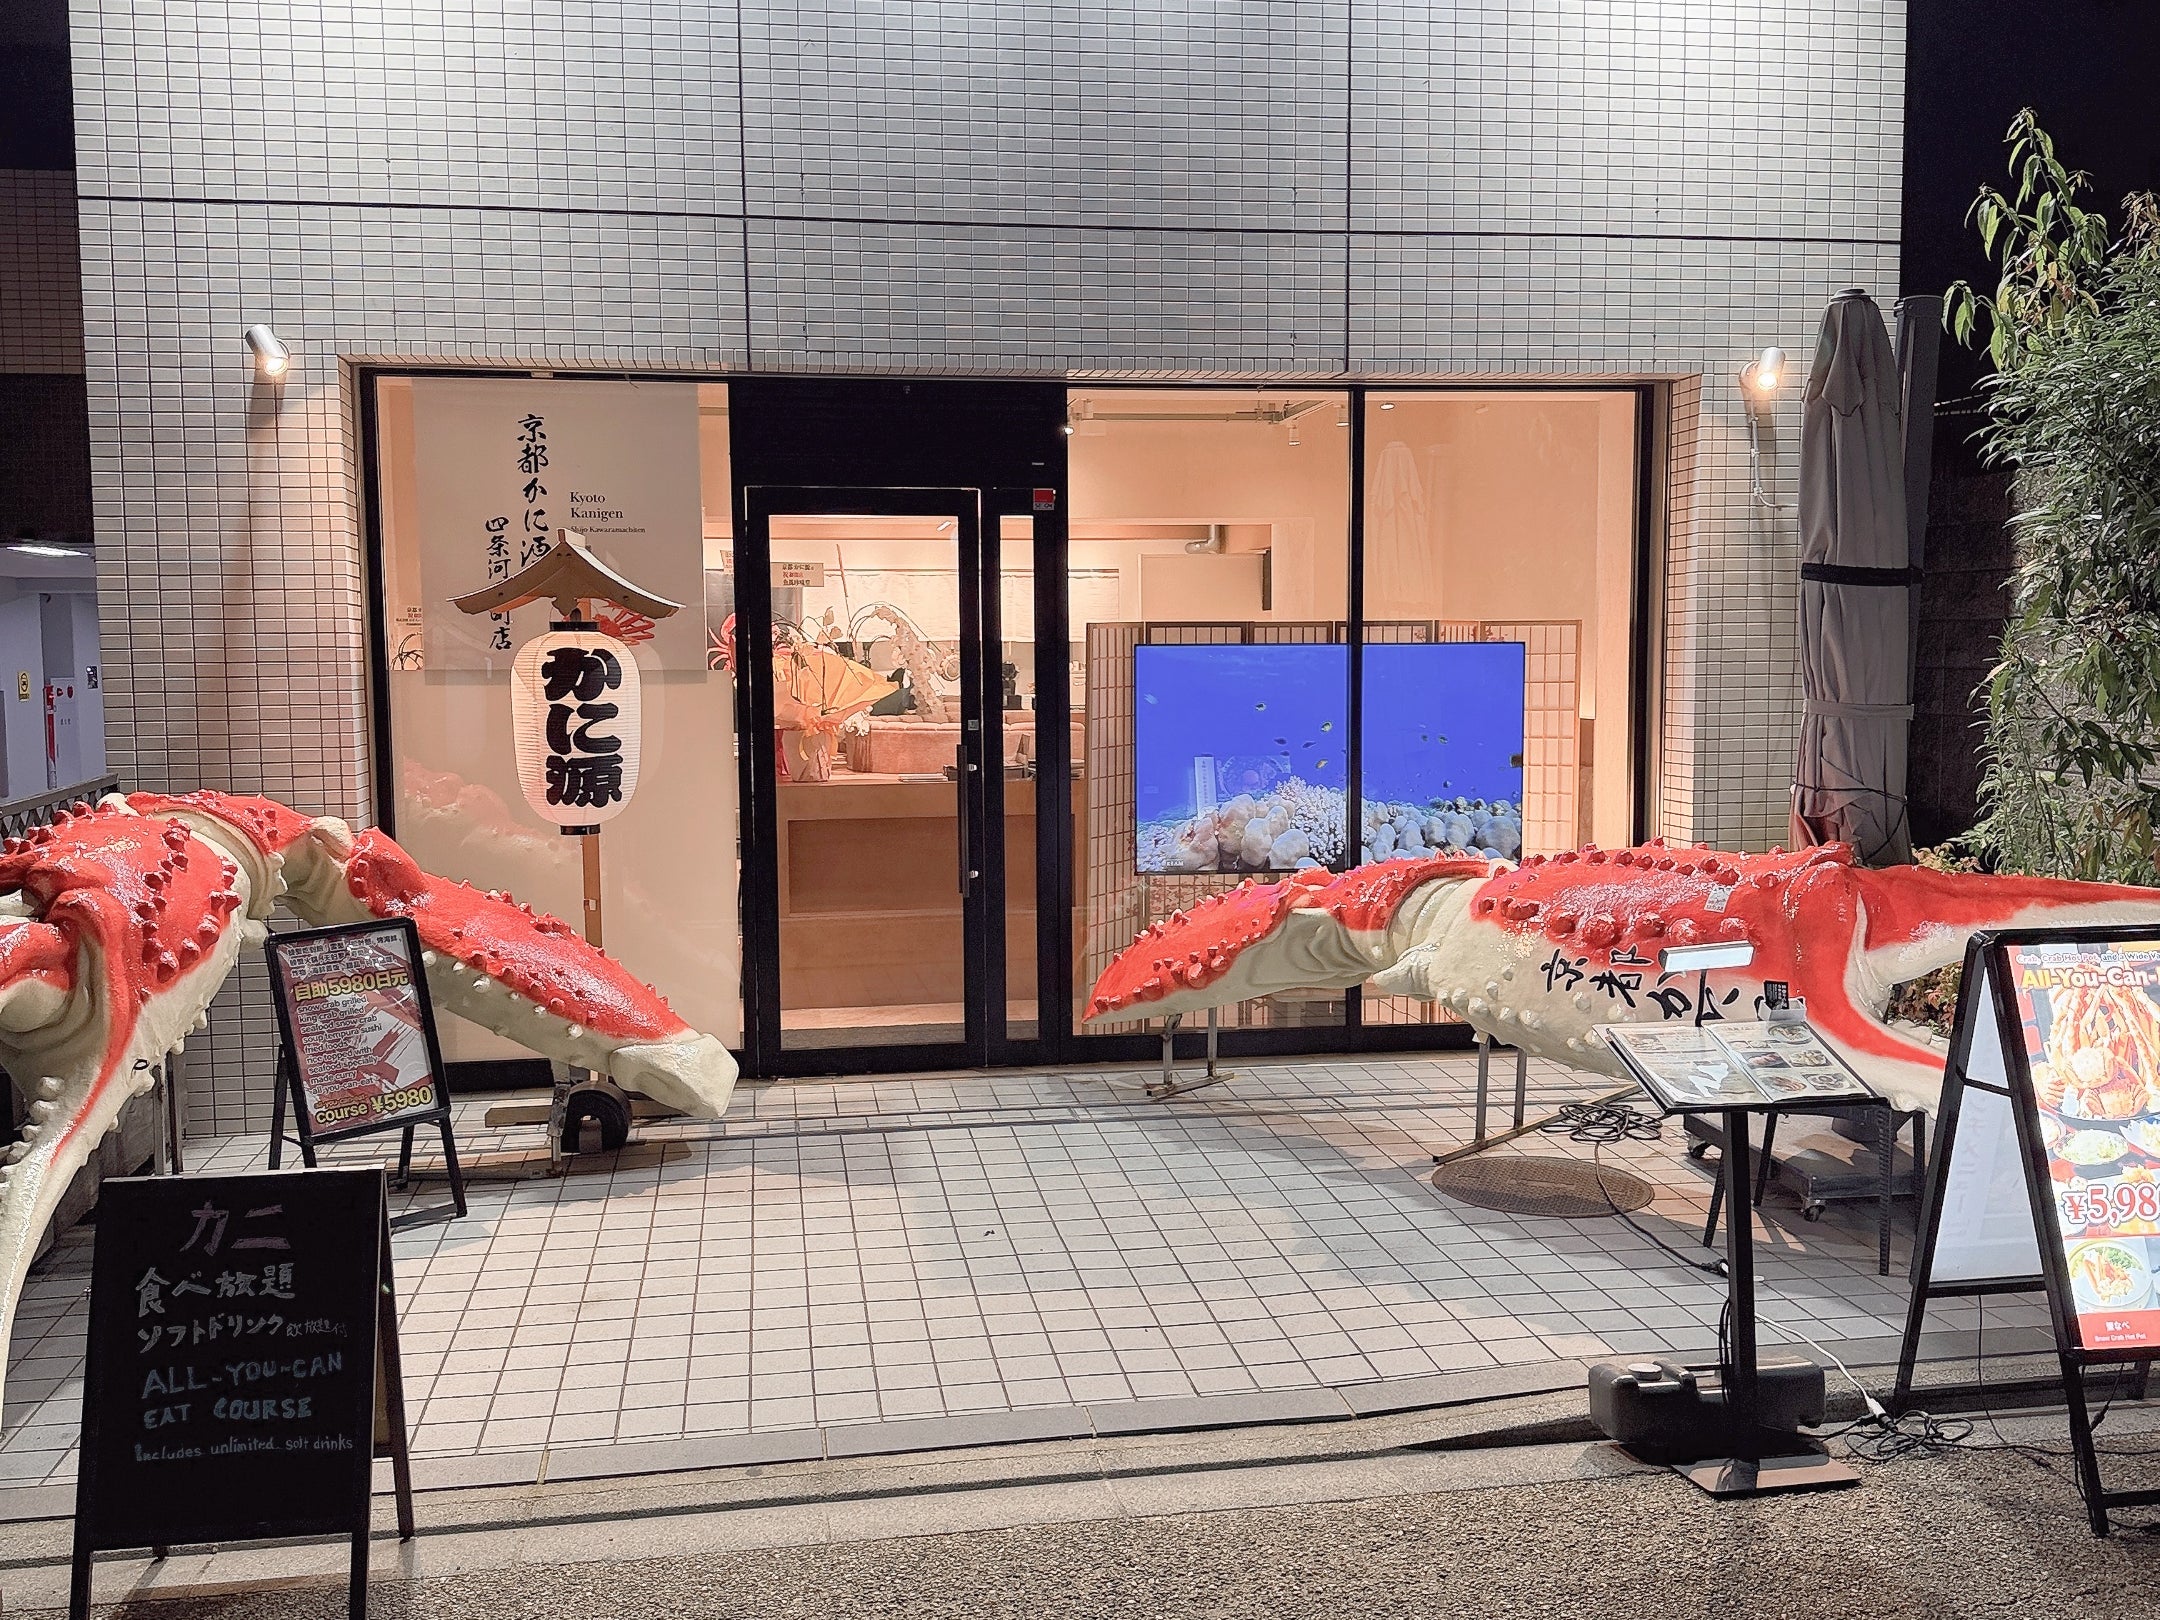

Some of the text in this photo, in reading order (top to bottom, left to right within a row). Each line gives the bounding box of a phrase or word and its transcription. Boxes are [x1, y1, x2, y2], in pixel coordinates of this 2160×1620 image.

[570, 491, 606, 506] Kyoto
[571, 507, 624, 522] Kanigen
[485, 516, 512, 651] 四条河町店
[541, 647, 624, 808] かに源
[294, 969, 409, 1002] 自助5980日元
[1540, 944, 1805, 1021] 京都かに
[298, 996, 367, 1013] snow crab grilled
[299, 1006, 364, 1024] king crab grilled
[301, 1015, 378, 1034] seafood snow crab
[303, 1024, 383, 1044] soup tempura sushi
[304, 1041, 349, 1055] fried foods
[324, 1050, 353, 1063] topped
[354, 1046, 372, 1056] with
[308, 1062, 342, 1075] seafood
[310, 1070, 357, 1085] made curry
[316, 1086, 433, 1123] course ¥5980
[2066, 1183, 2160, 1225] ¥5,98
[179, 1200, 291, 1256] カニ
[135, 1262, 296, 1318] 食べ放題
[137, 1313, 284, 1354] ソフトドリンク
[143, 1397, 313, 1430] EAT COURSE
[313, 1432, 354, 1451] drinks
